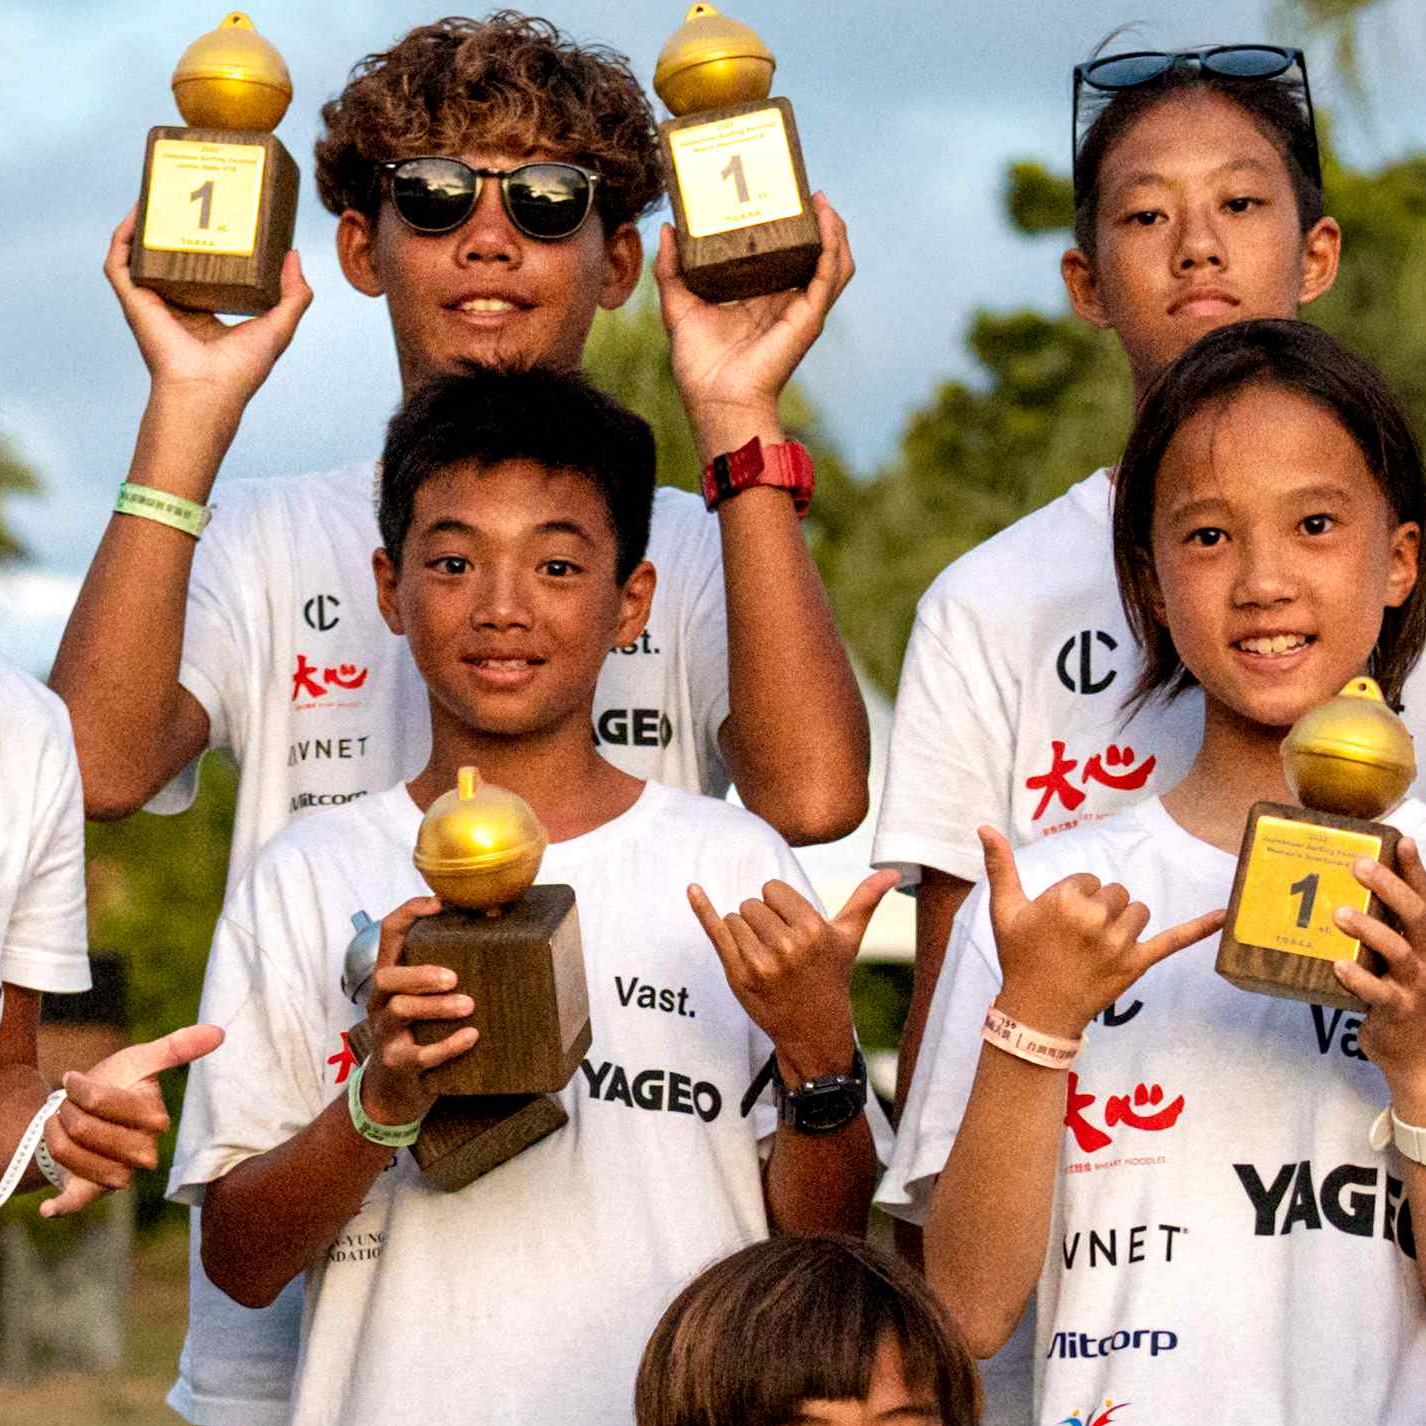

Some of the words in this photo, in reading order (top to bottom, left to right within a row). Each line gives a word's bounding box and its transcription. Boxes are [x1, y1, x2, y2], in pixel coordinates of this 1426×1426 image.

[720, 155, 750, 203] 1
[189, 180, 215, 230] 1
[593, 708, 672, 750] GEO
[1026, 741, 1156, 820] 大心
[1290, 872, 1320, 929] 1
[615, 975, 696, 1018] Vast.
[1310, 1004, 1369, 1061] Va
[580, 1060, 722, 1123] YAGEO
[1063, 1224, 1181, 1270] VNET
